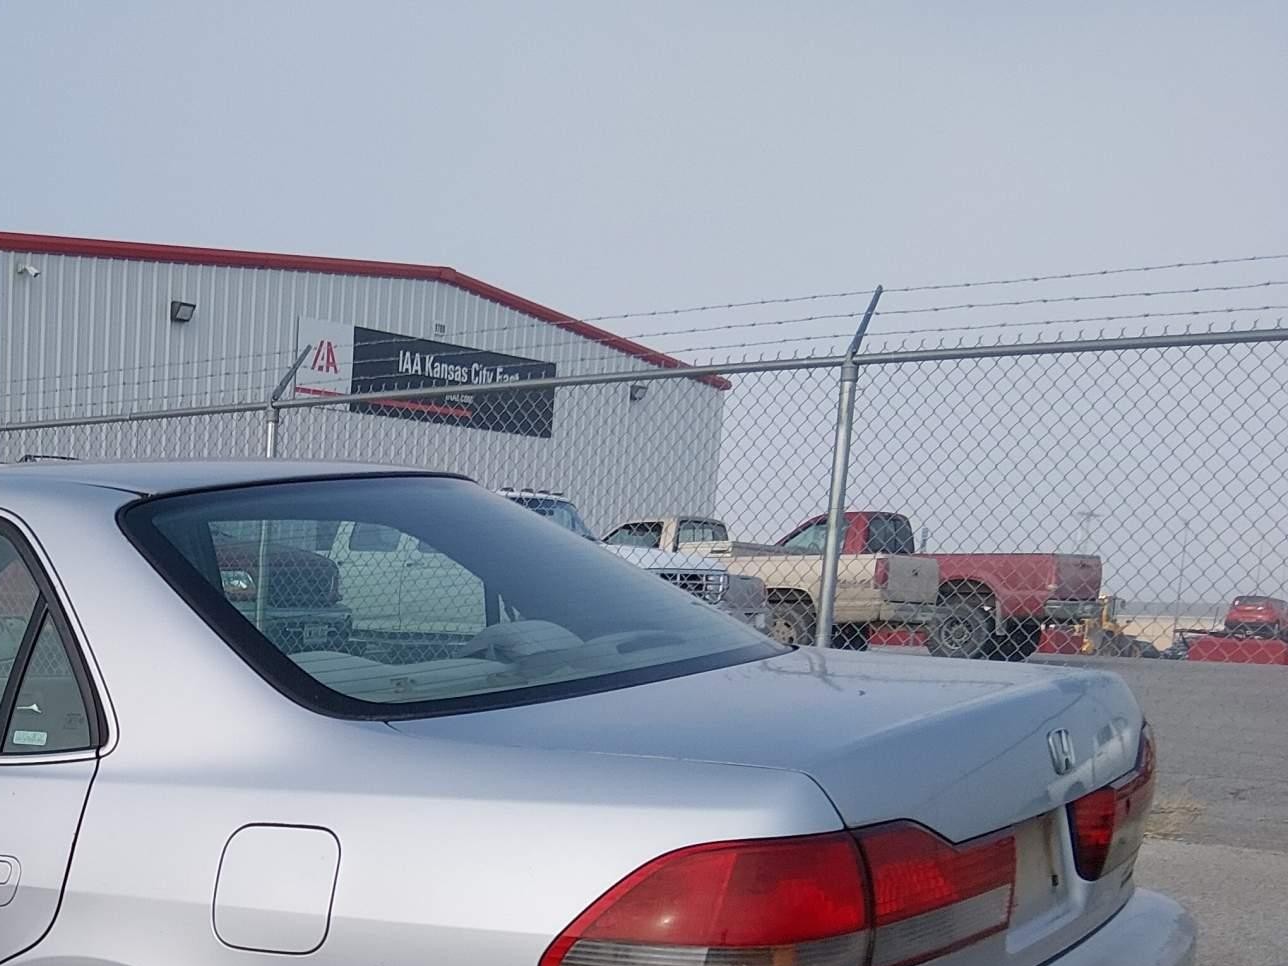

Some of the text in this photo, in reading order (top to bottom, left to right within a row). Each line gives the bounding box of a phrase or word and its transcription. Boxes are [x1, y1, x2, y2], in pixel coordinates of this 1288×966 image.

[398, 350, 422, 376] IAA
[425, 354, 468, 383] Kansas
[471, 363, 494, 385] City
